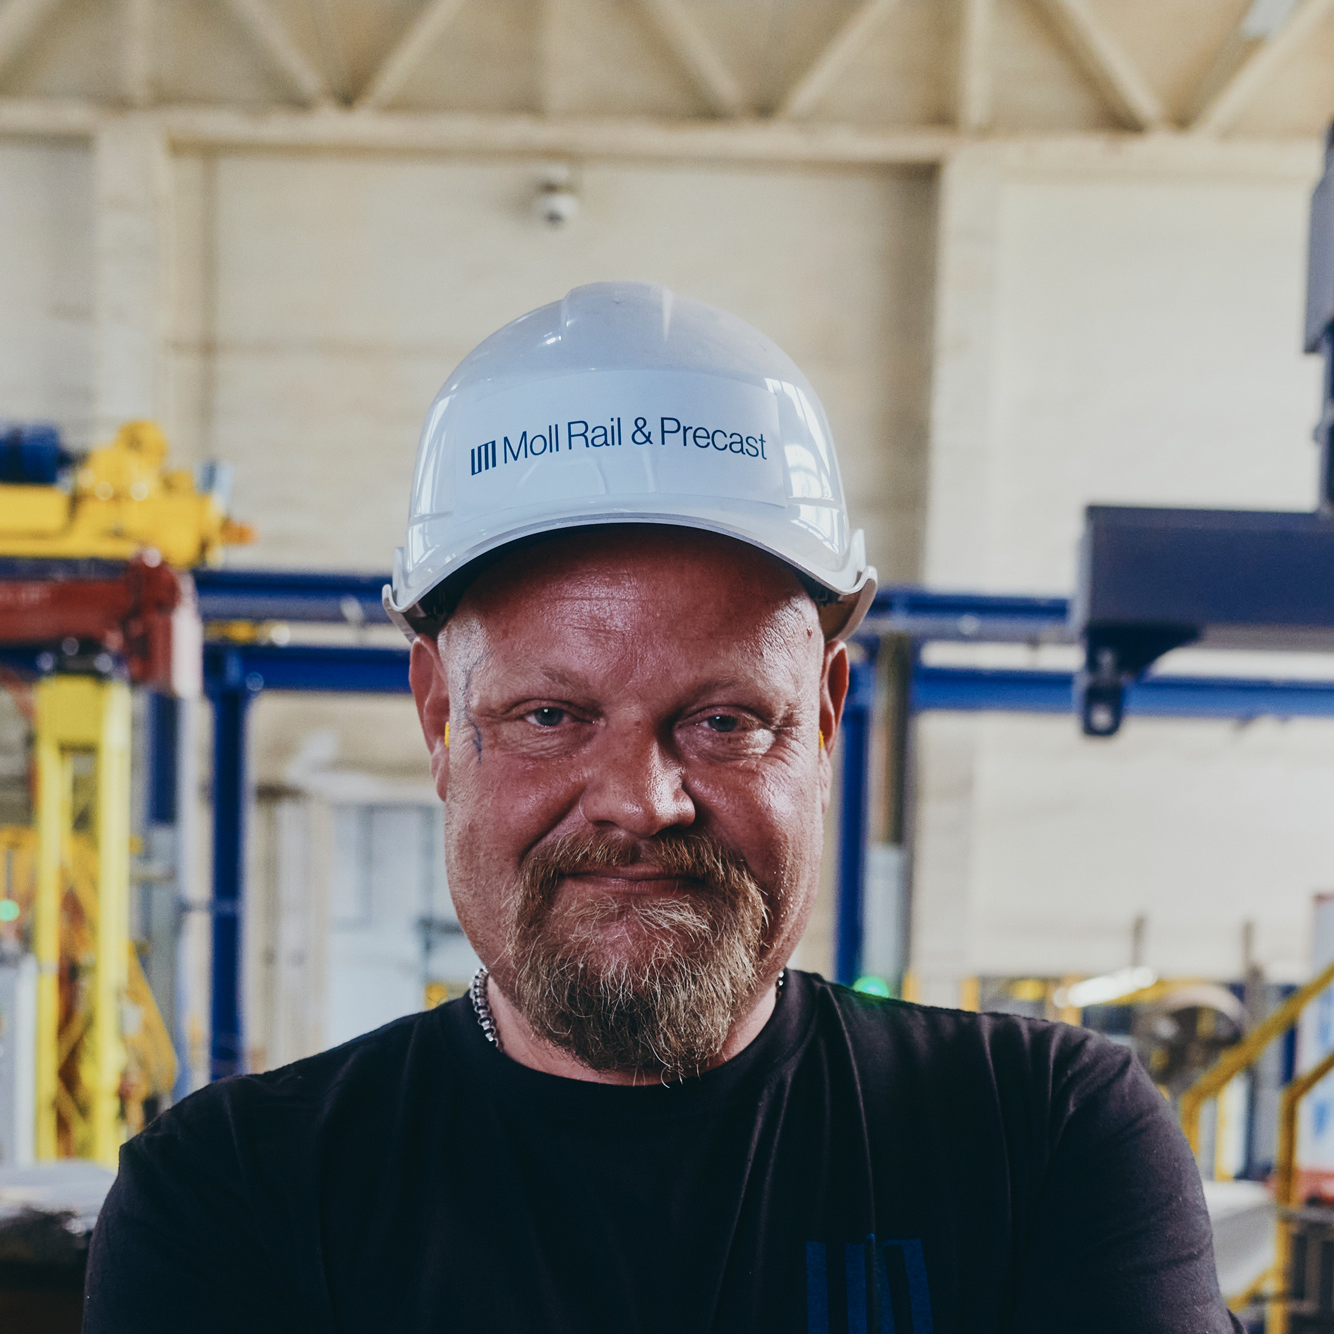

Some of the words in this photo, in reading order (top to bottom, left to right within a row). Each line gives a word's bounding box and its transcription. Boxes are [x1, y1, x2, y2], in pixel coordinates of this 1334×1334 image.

[503, 423, 560, 465] Moll
[567, 416, 622, 451] Rail
[631, 416, 654, 446] &
[660, 416, 768, 460] Precast
